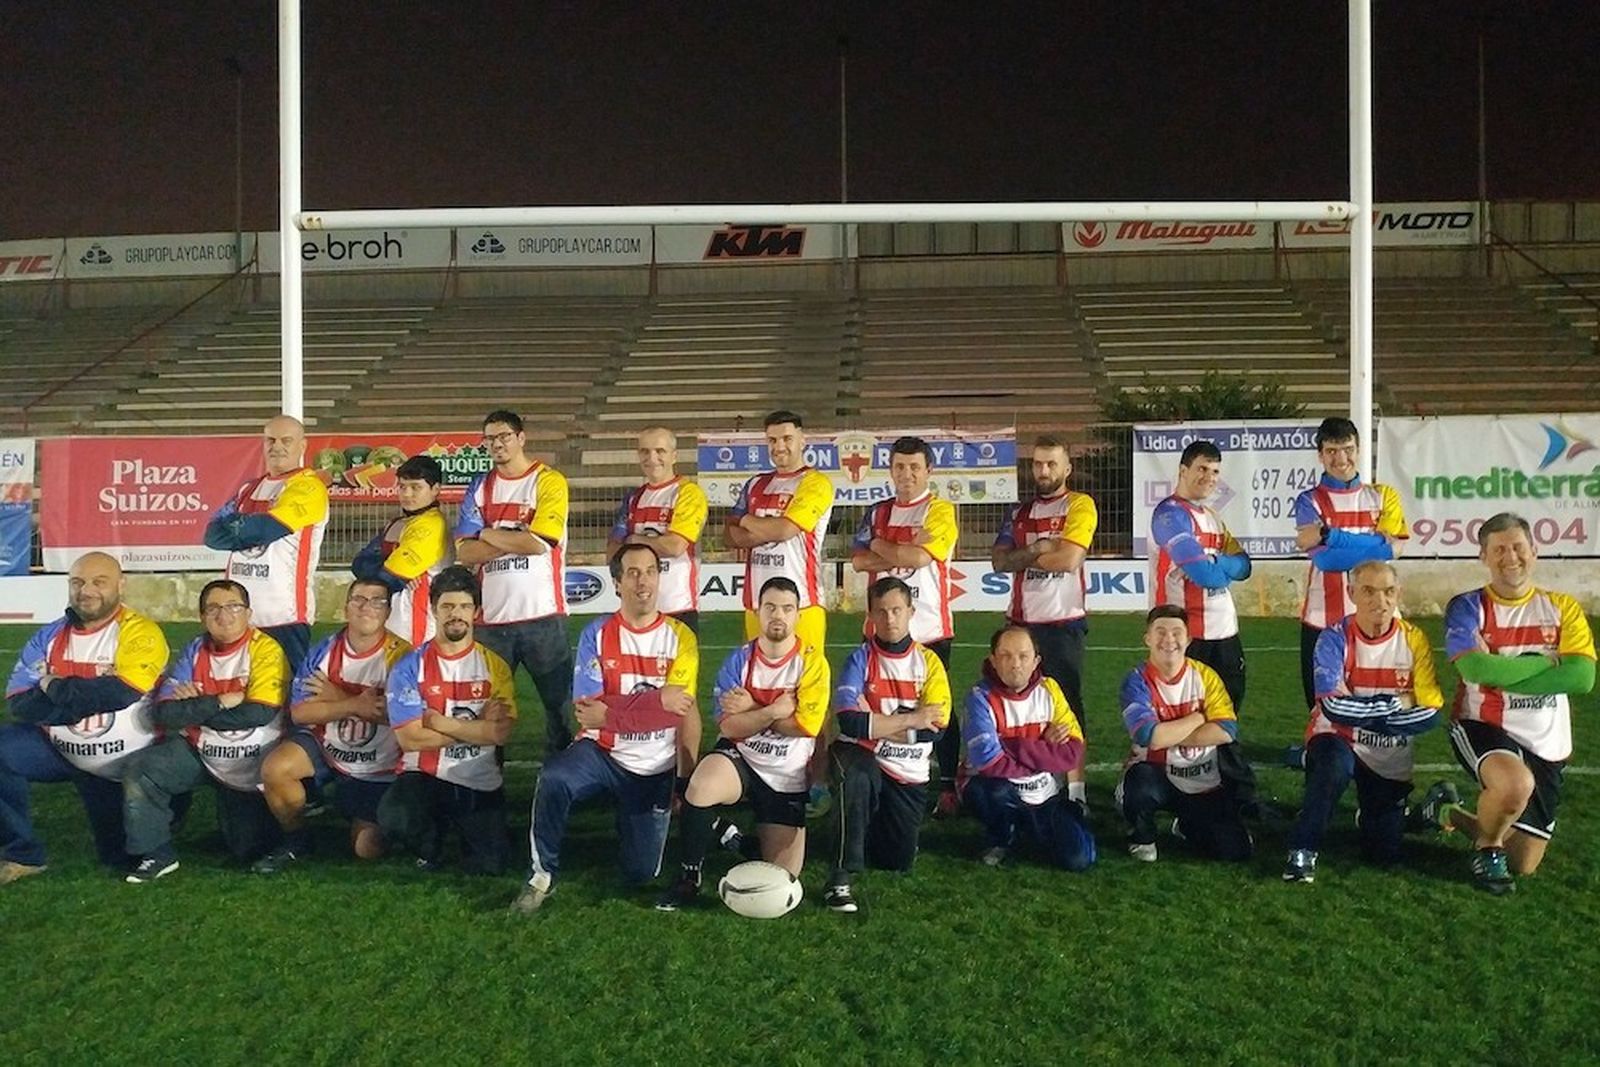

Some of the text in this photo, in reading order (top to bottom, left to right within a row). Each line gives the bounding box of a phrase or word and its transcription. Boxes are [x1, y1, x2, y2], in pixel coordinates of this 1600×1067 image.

[518, 237, 641, 254] GRUPOPLAYCAR.COM
[707, 224, 803, 257] KTM
[1143, 436, 1177, 450] Lidia
[112, 458, 197, 486] Plaza
[1252, 467, 1317, 491] 697 424
[99, 486, 209, 512] Suizos.
[834, 481, 893, 501] MERÍ
[1252, 496, 1281, 518] 950
[121, 551, 215, 564] plazasuizos.com
